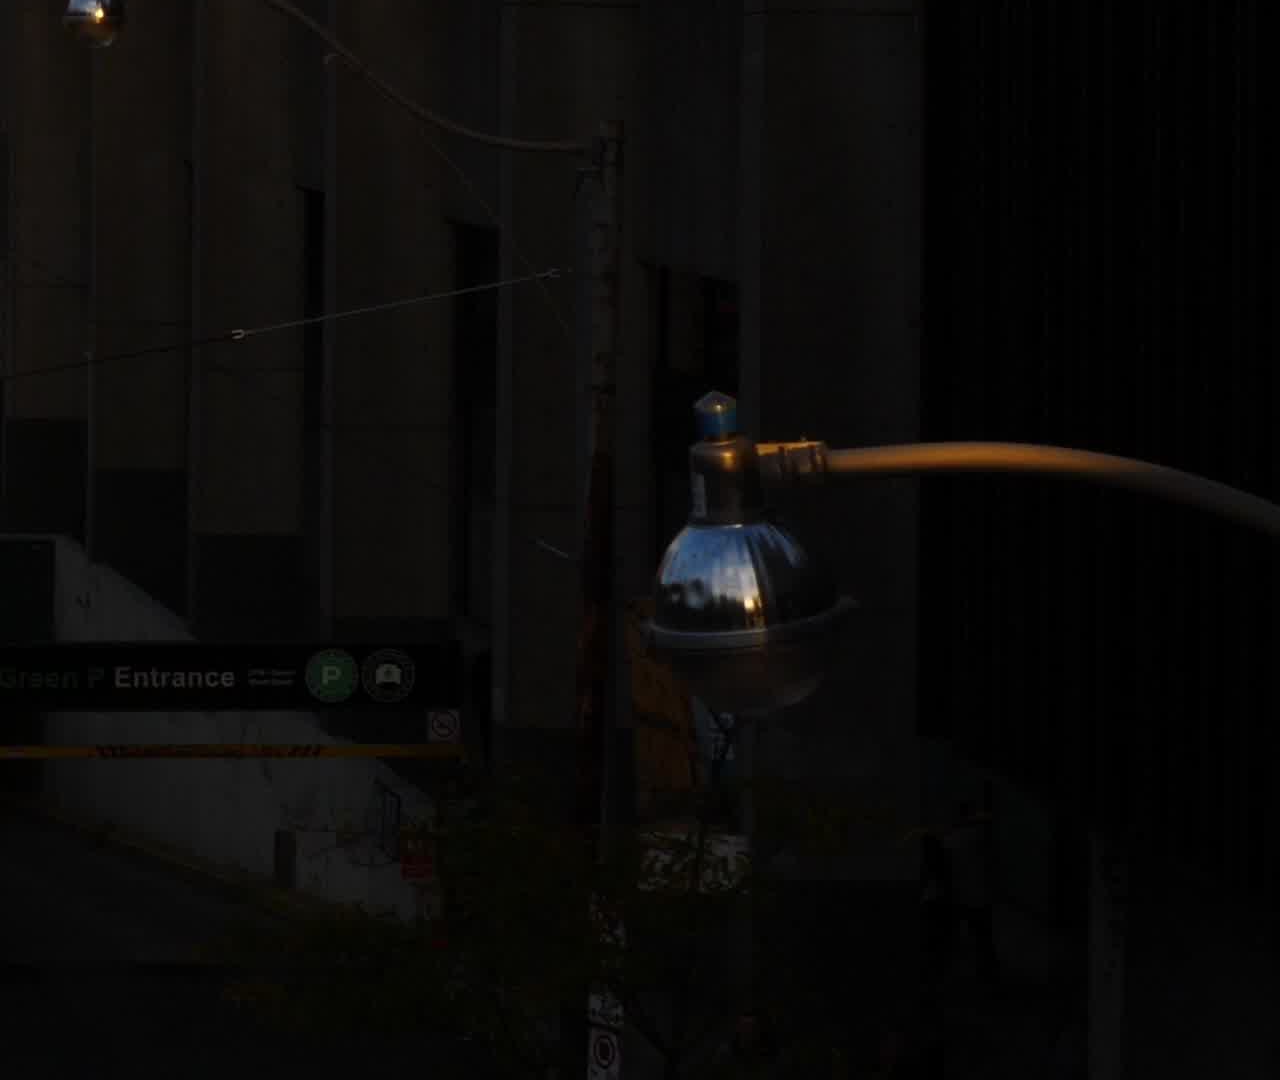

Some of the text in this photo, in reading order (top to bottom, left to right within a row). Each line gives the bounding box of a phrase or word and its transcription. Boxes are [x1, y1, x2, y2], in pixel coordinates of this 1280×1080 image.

[88, 665, 105, 689] P
[113, 665, 236, 689] Entrance
[322, 665, 342, 686] P
